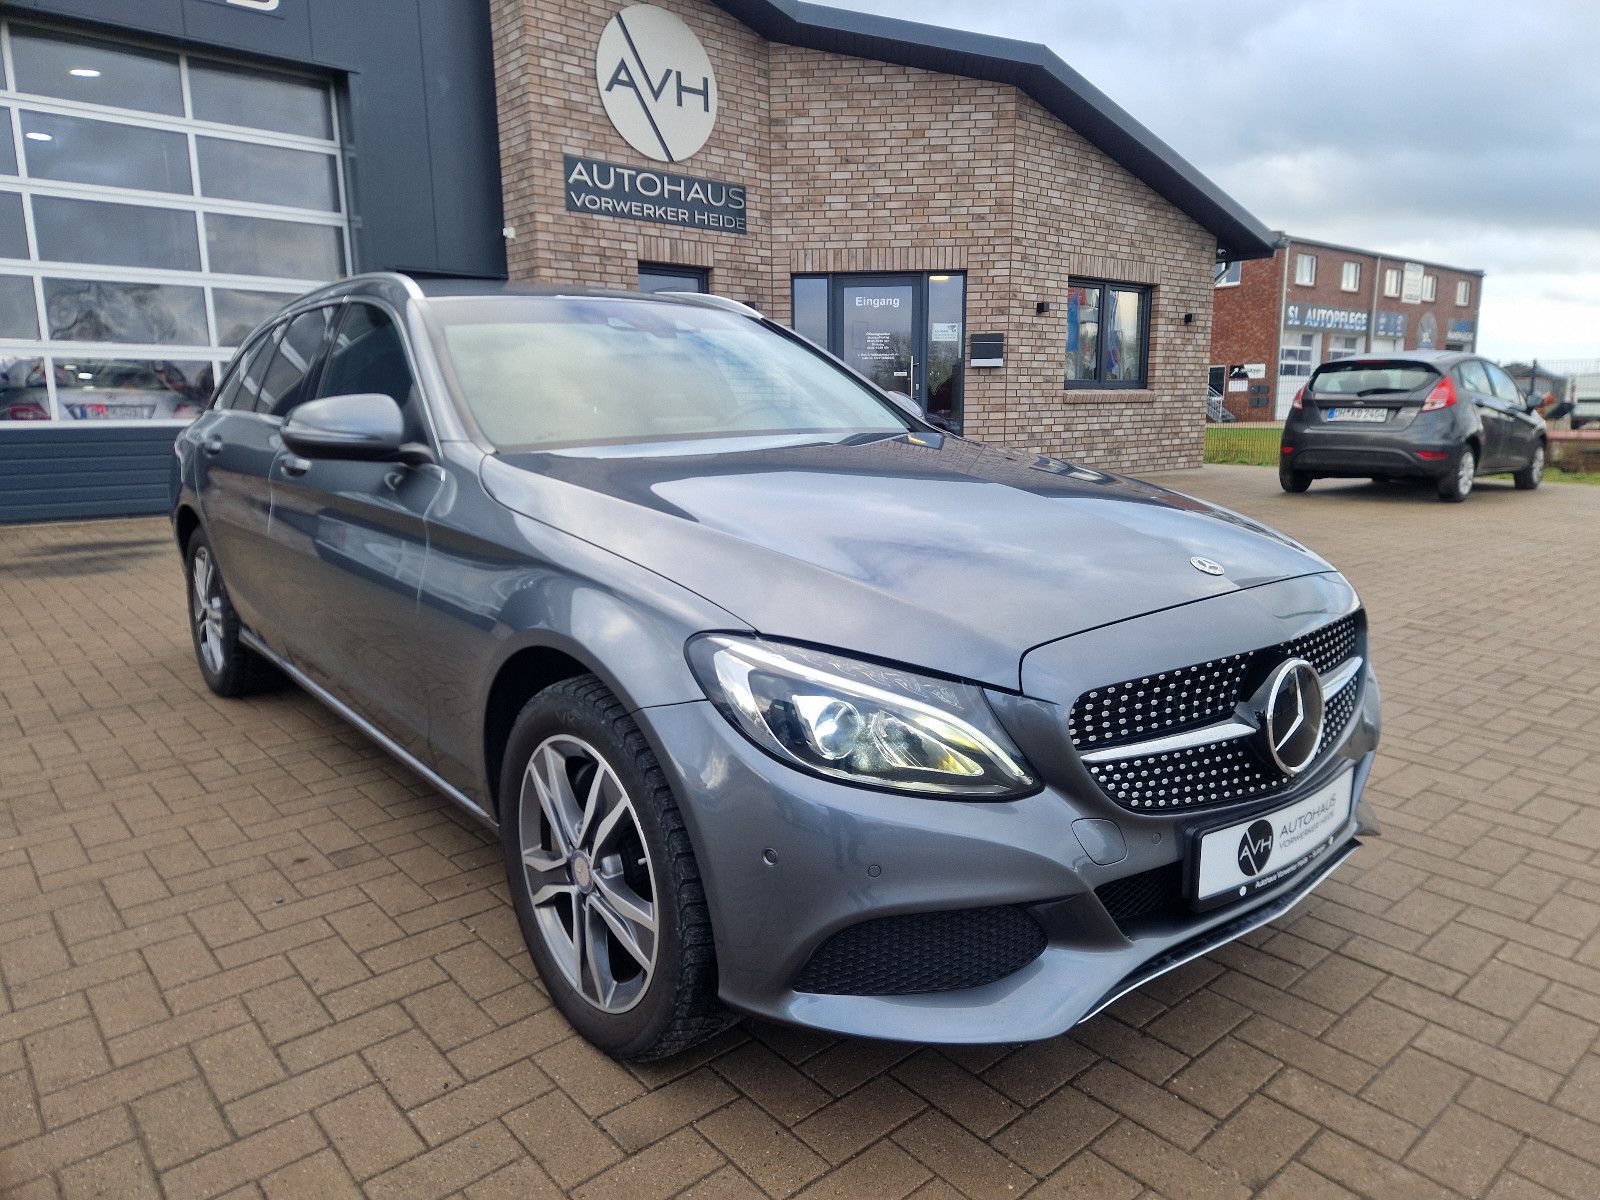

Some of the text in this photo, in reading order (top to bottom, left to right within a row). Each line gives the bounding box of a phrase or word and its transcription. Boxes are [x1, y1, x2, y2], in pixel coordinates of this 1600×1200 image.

[605, 57, 710, 113] AVH
[568, 162, 745, 210] AUTOHAUS
[570, 191, 745, 230] VORWERKER HEIDE
[855, 296, 900, 308] Eingang
[1287, 305, 1368, 331] SL AUTOPFLEGE
[1279, 793, 1336, 839] AUTOHAUS
[1239, 834, 1272, 862] AVH
